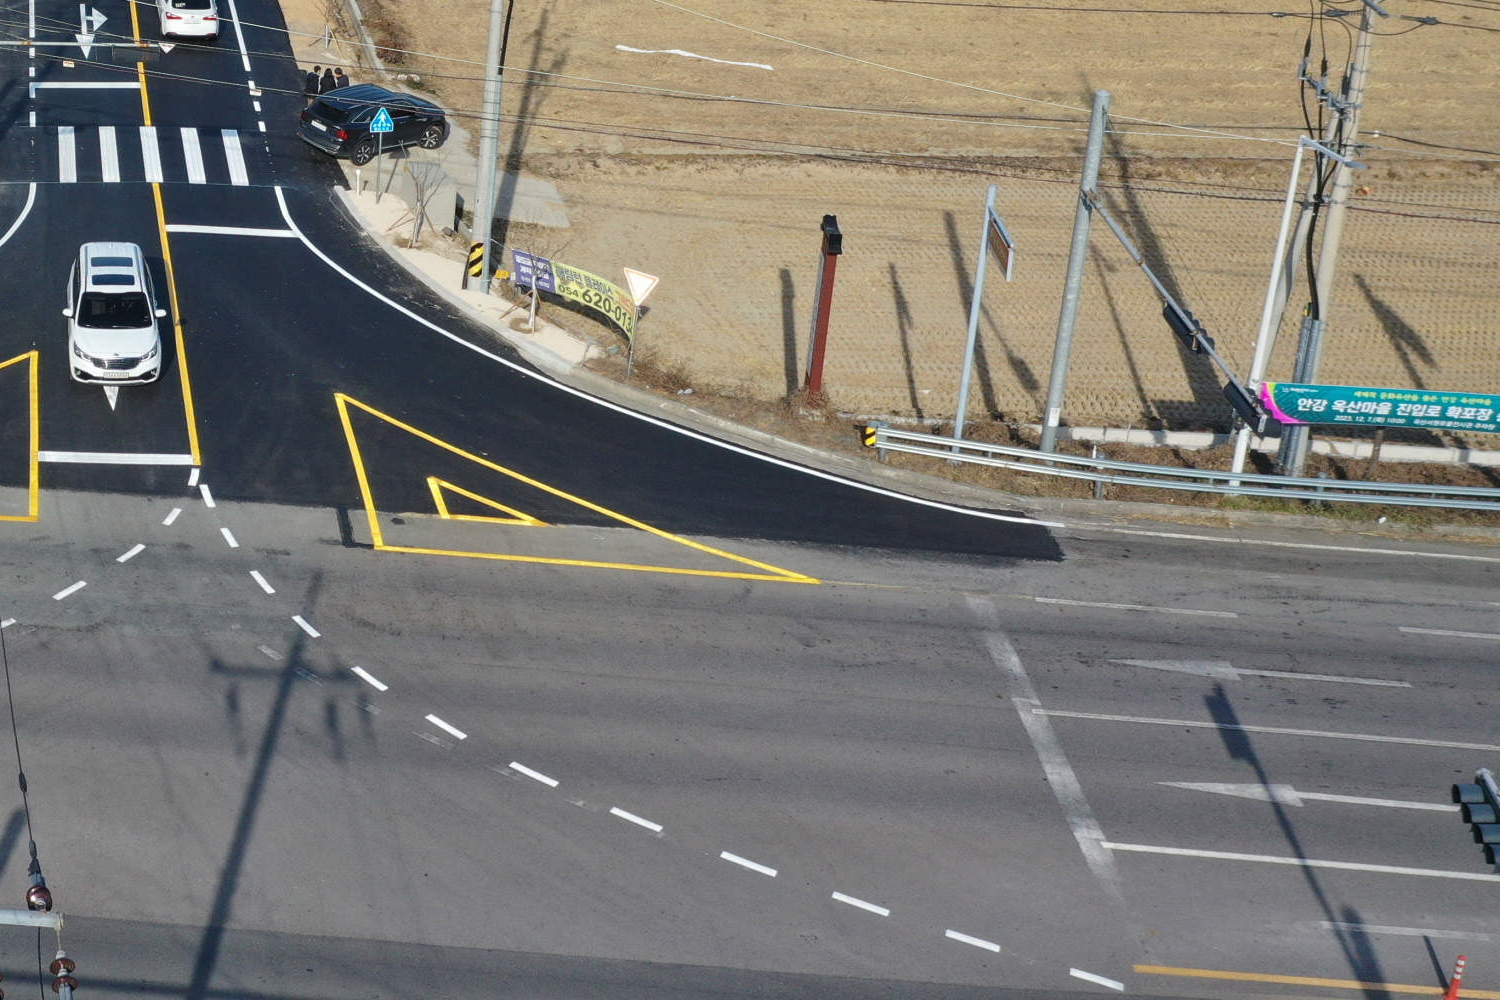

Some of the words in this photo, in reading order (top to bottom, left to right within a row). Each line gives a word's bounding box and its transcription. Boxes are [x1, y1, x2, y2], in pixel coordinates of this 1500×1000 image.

[1297, 397, 1328, 412] 안강
[1331, 399, 1392, 415] 옥산마을
[1396, 403, 1442, 417] 진입로
[1445, 405, 1494, 421] 확포장
